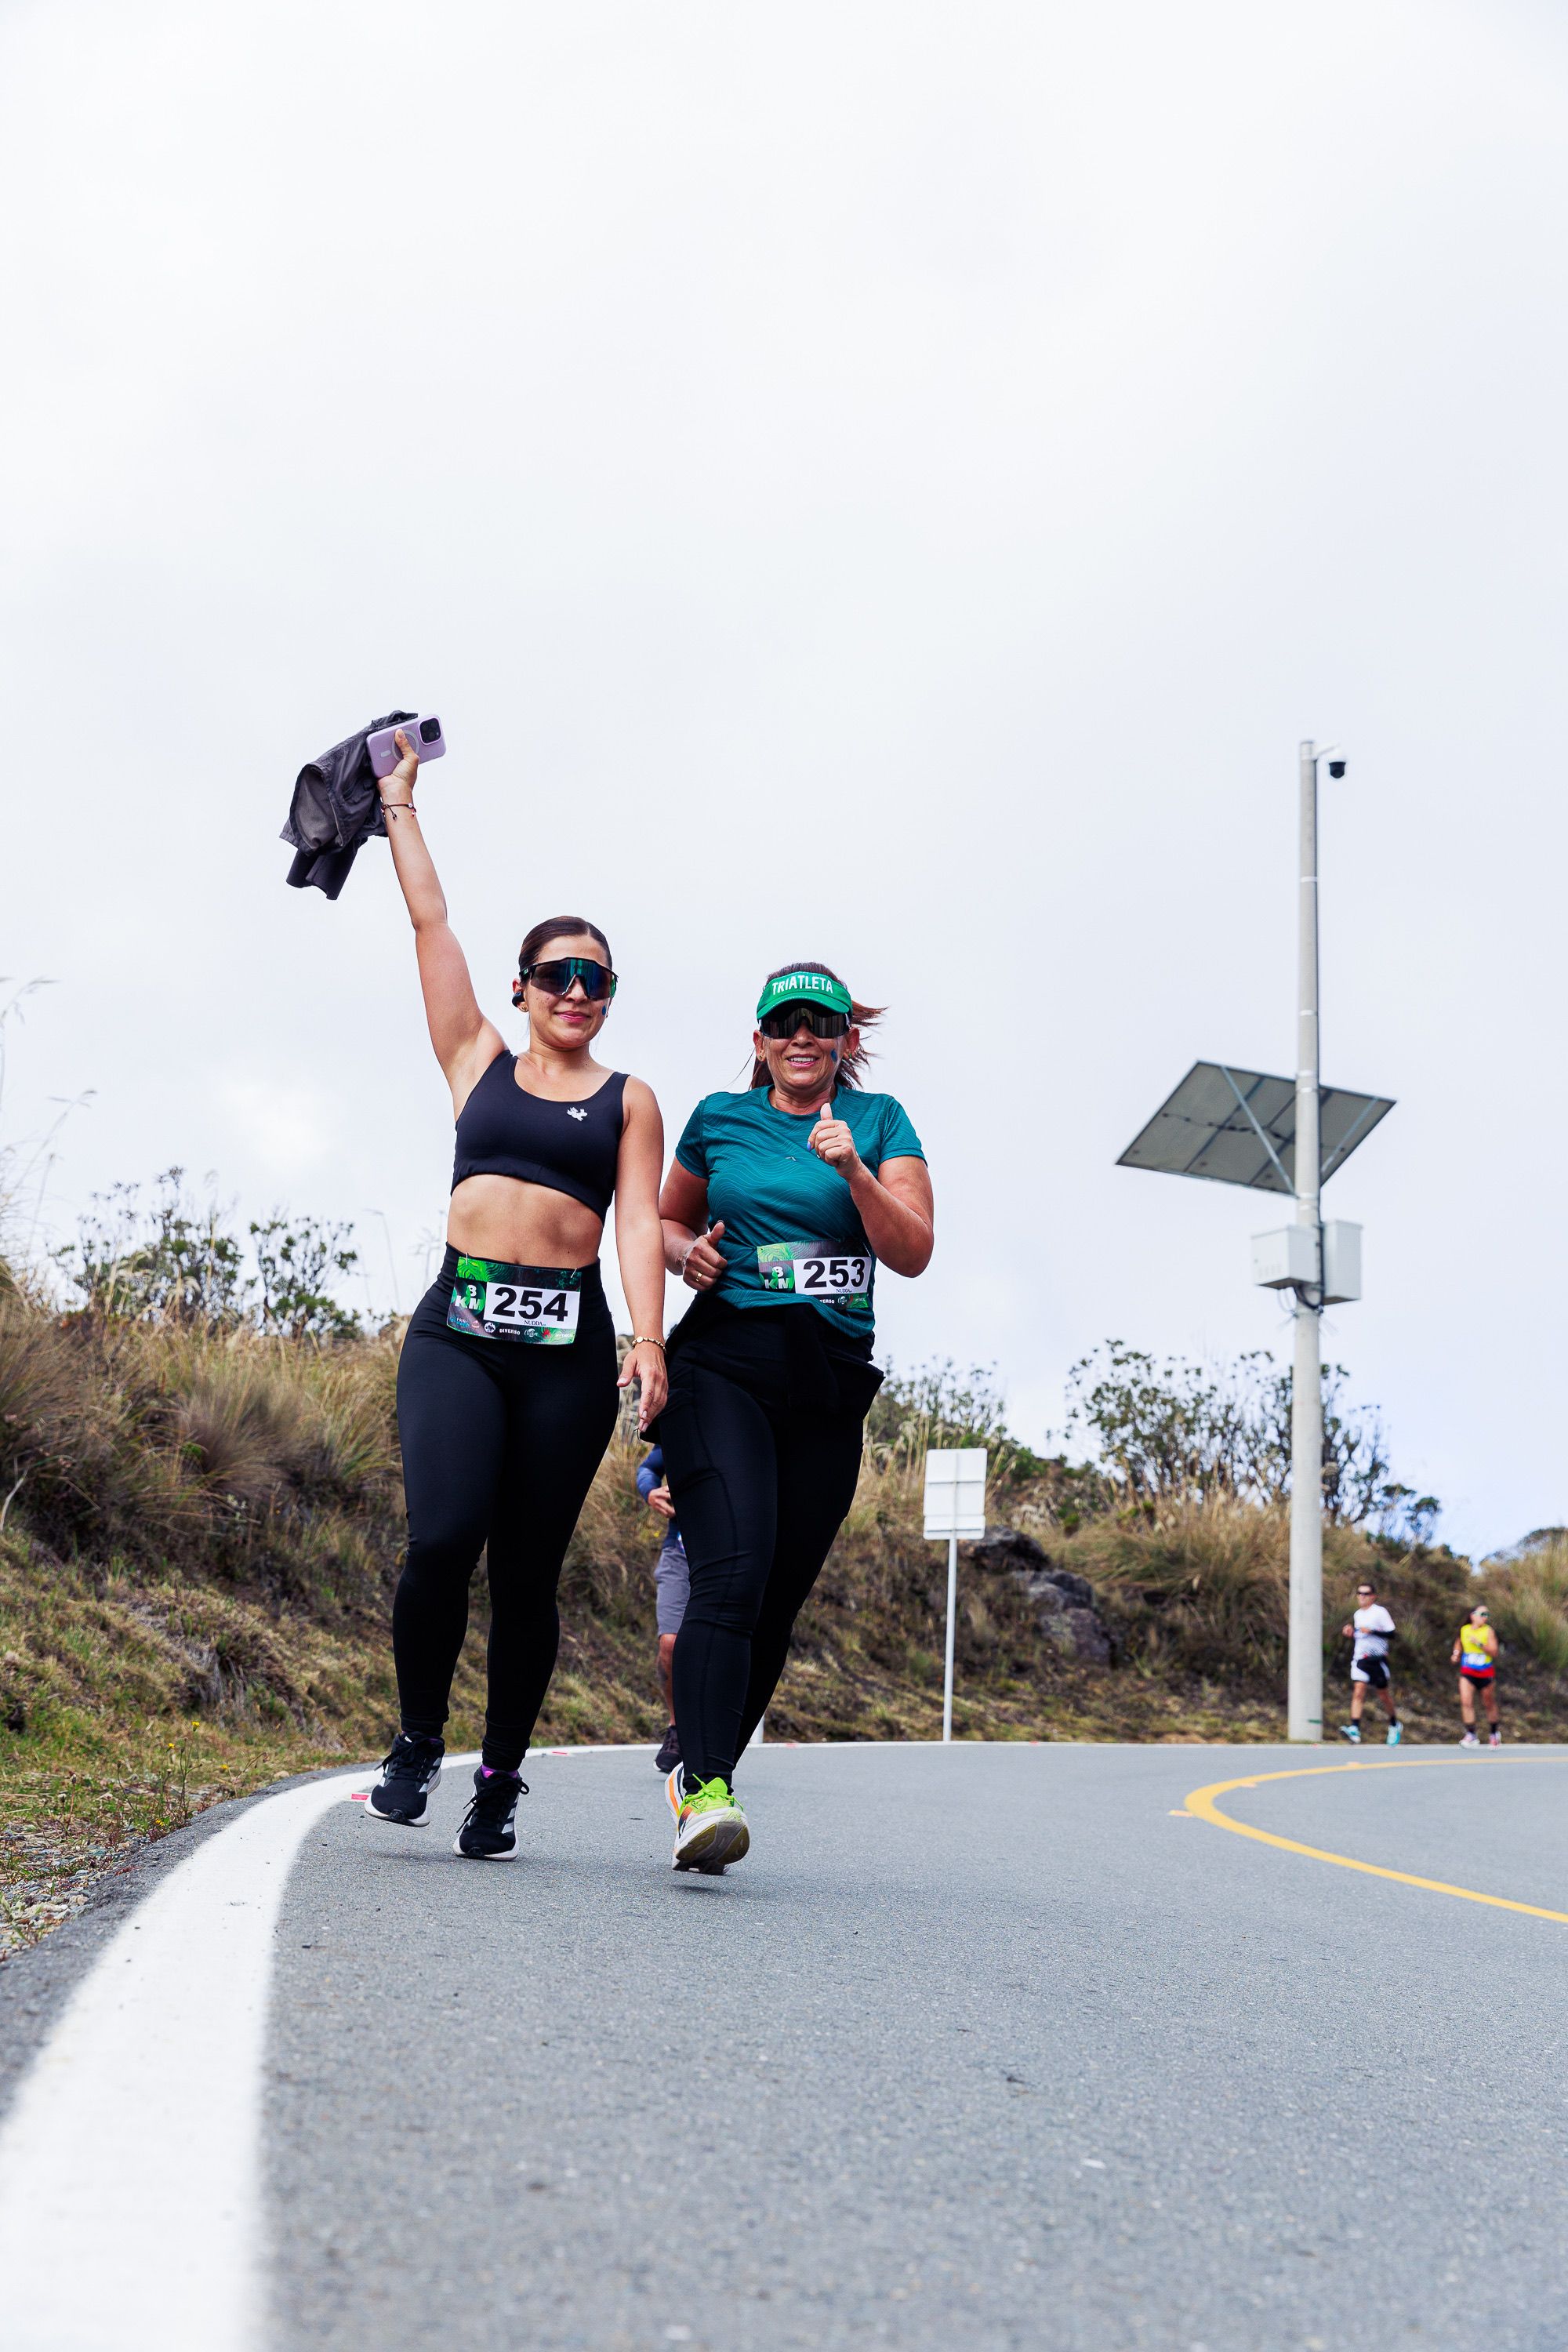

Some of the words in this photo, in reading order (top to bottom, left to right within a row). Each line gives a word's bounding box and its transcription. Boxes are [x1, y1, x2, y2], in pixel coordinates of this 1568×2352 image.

[772, 975, 833, 996] TRIATLETA
[764, 1277, 791, 1290] KM
[803, 1258, 865, 1289] 253
[455, 1295, 482, 1311] KM
[492, 1287, 568, 1322] 254
